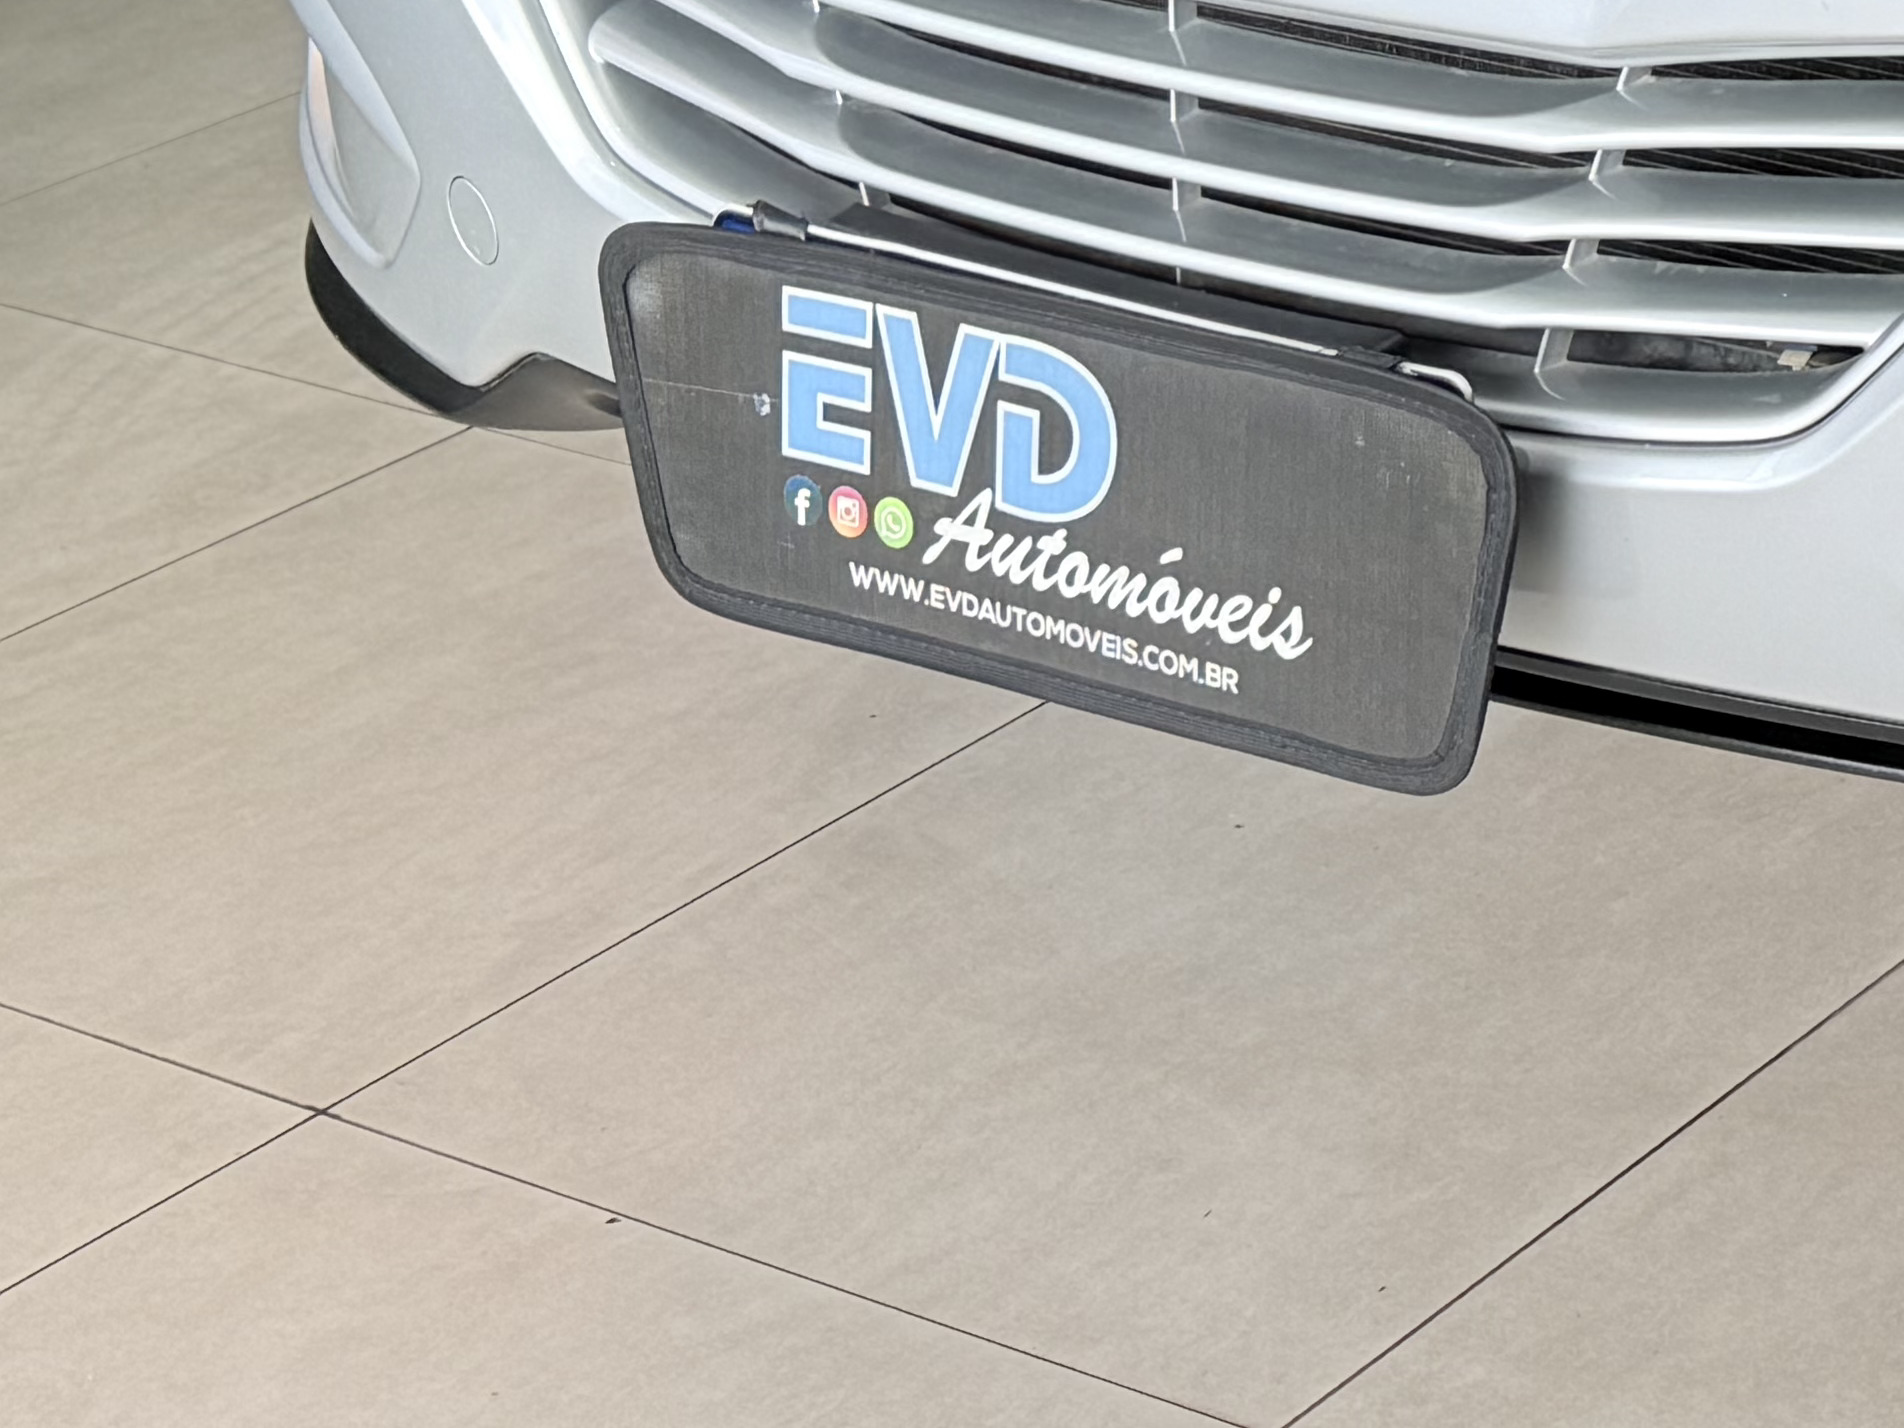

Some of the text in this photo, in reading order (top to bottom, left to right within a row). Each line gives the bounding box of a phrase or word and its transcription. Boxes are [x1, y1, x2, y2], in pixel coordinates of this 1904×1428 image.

[781, 284, 1118, 524] EVD
[848, 560, 1239, 696] WWW.EVDAUTOMOVEIS.COM.BR
[922, 487, 1314, 661] Automóveis
